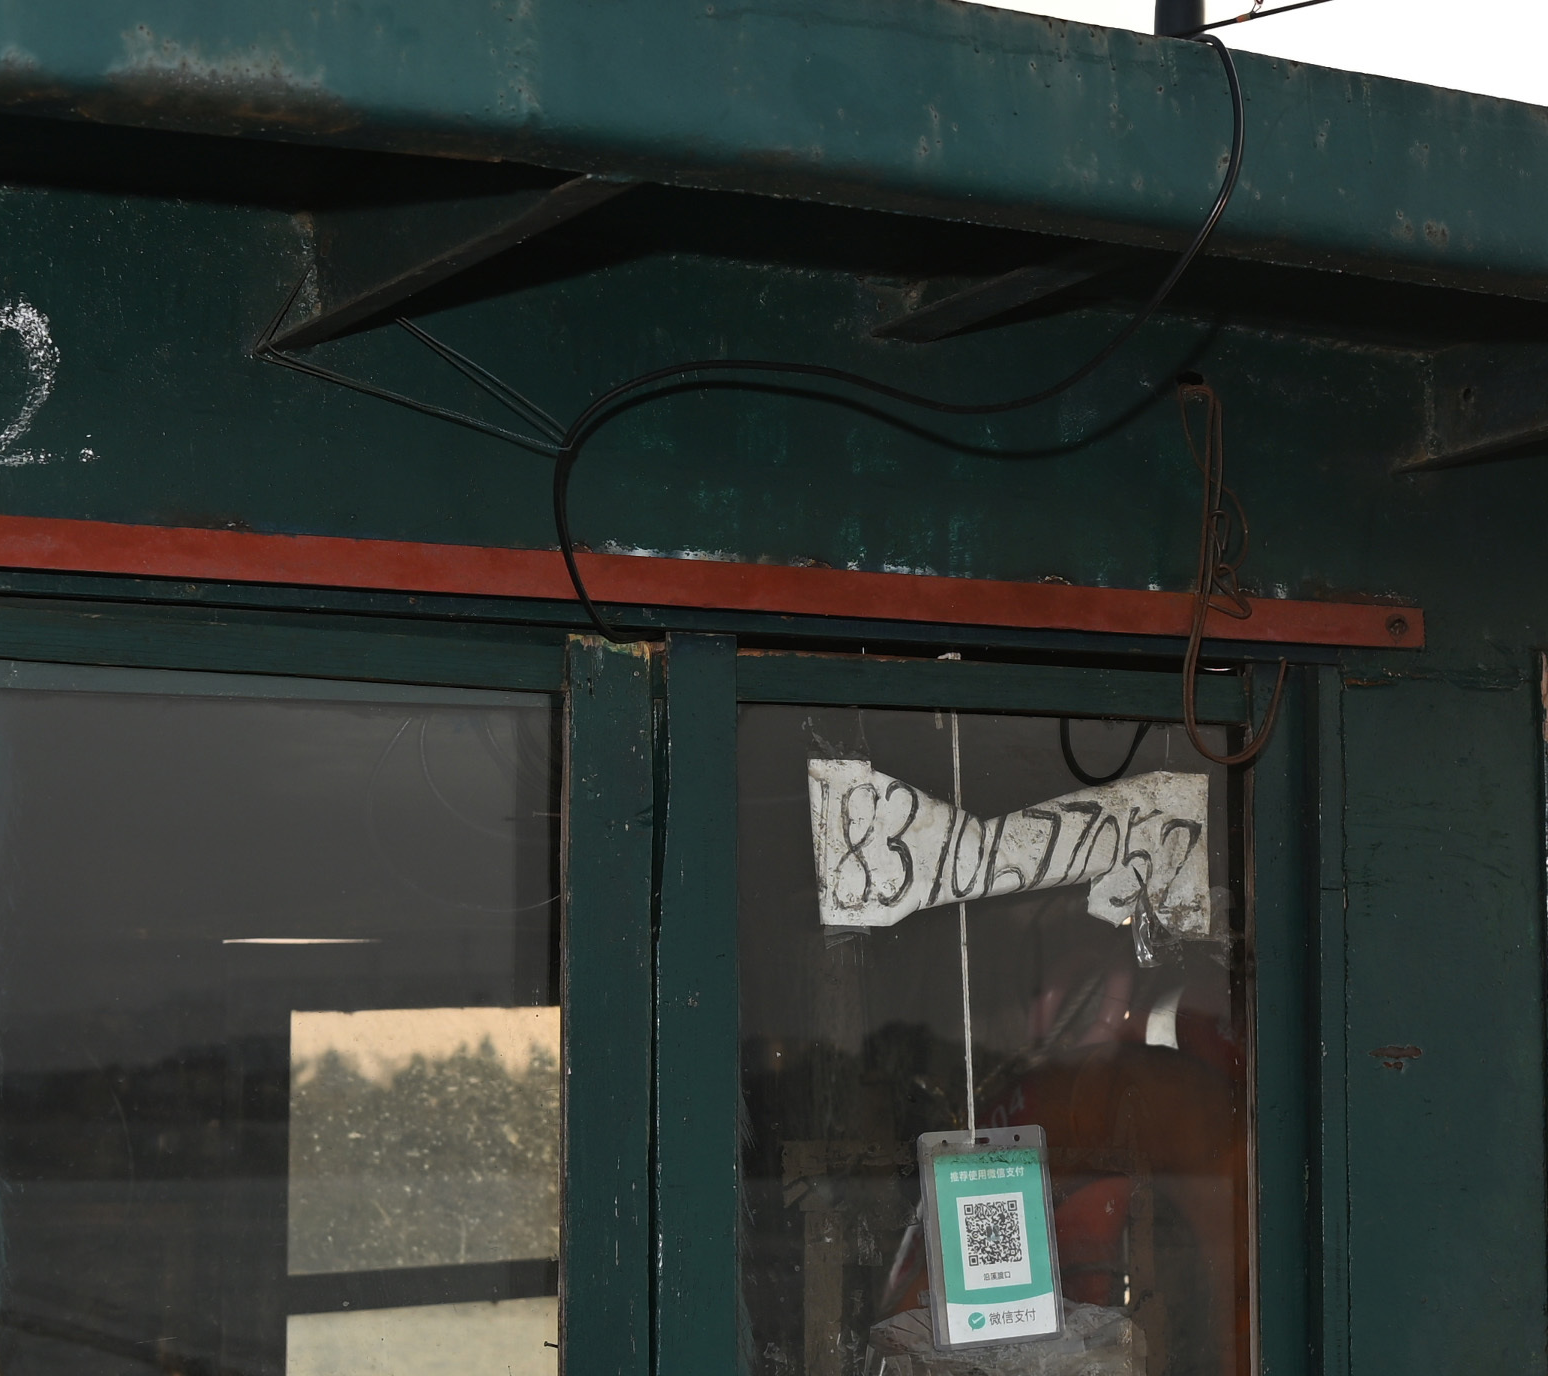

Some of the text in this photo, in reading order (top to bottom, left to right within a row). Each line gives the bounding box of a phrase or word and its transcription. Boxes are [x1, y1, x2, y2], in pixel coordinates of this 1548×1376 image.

[949, 1165, 1025, 1183] 推荐使用微信支付
[988, 1308, 1036, 1325] 微信支付
